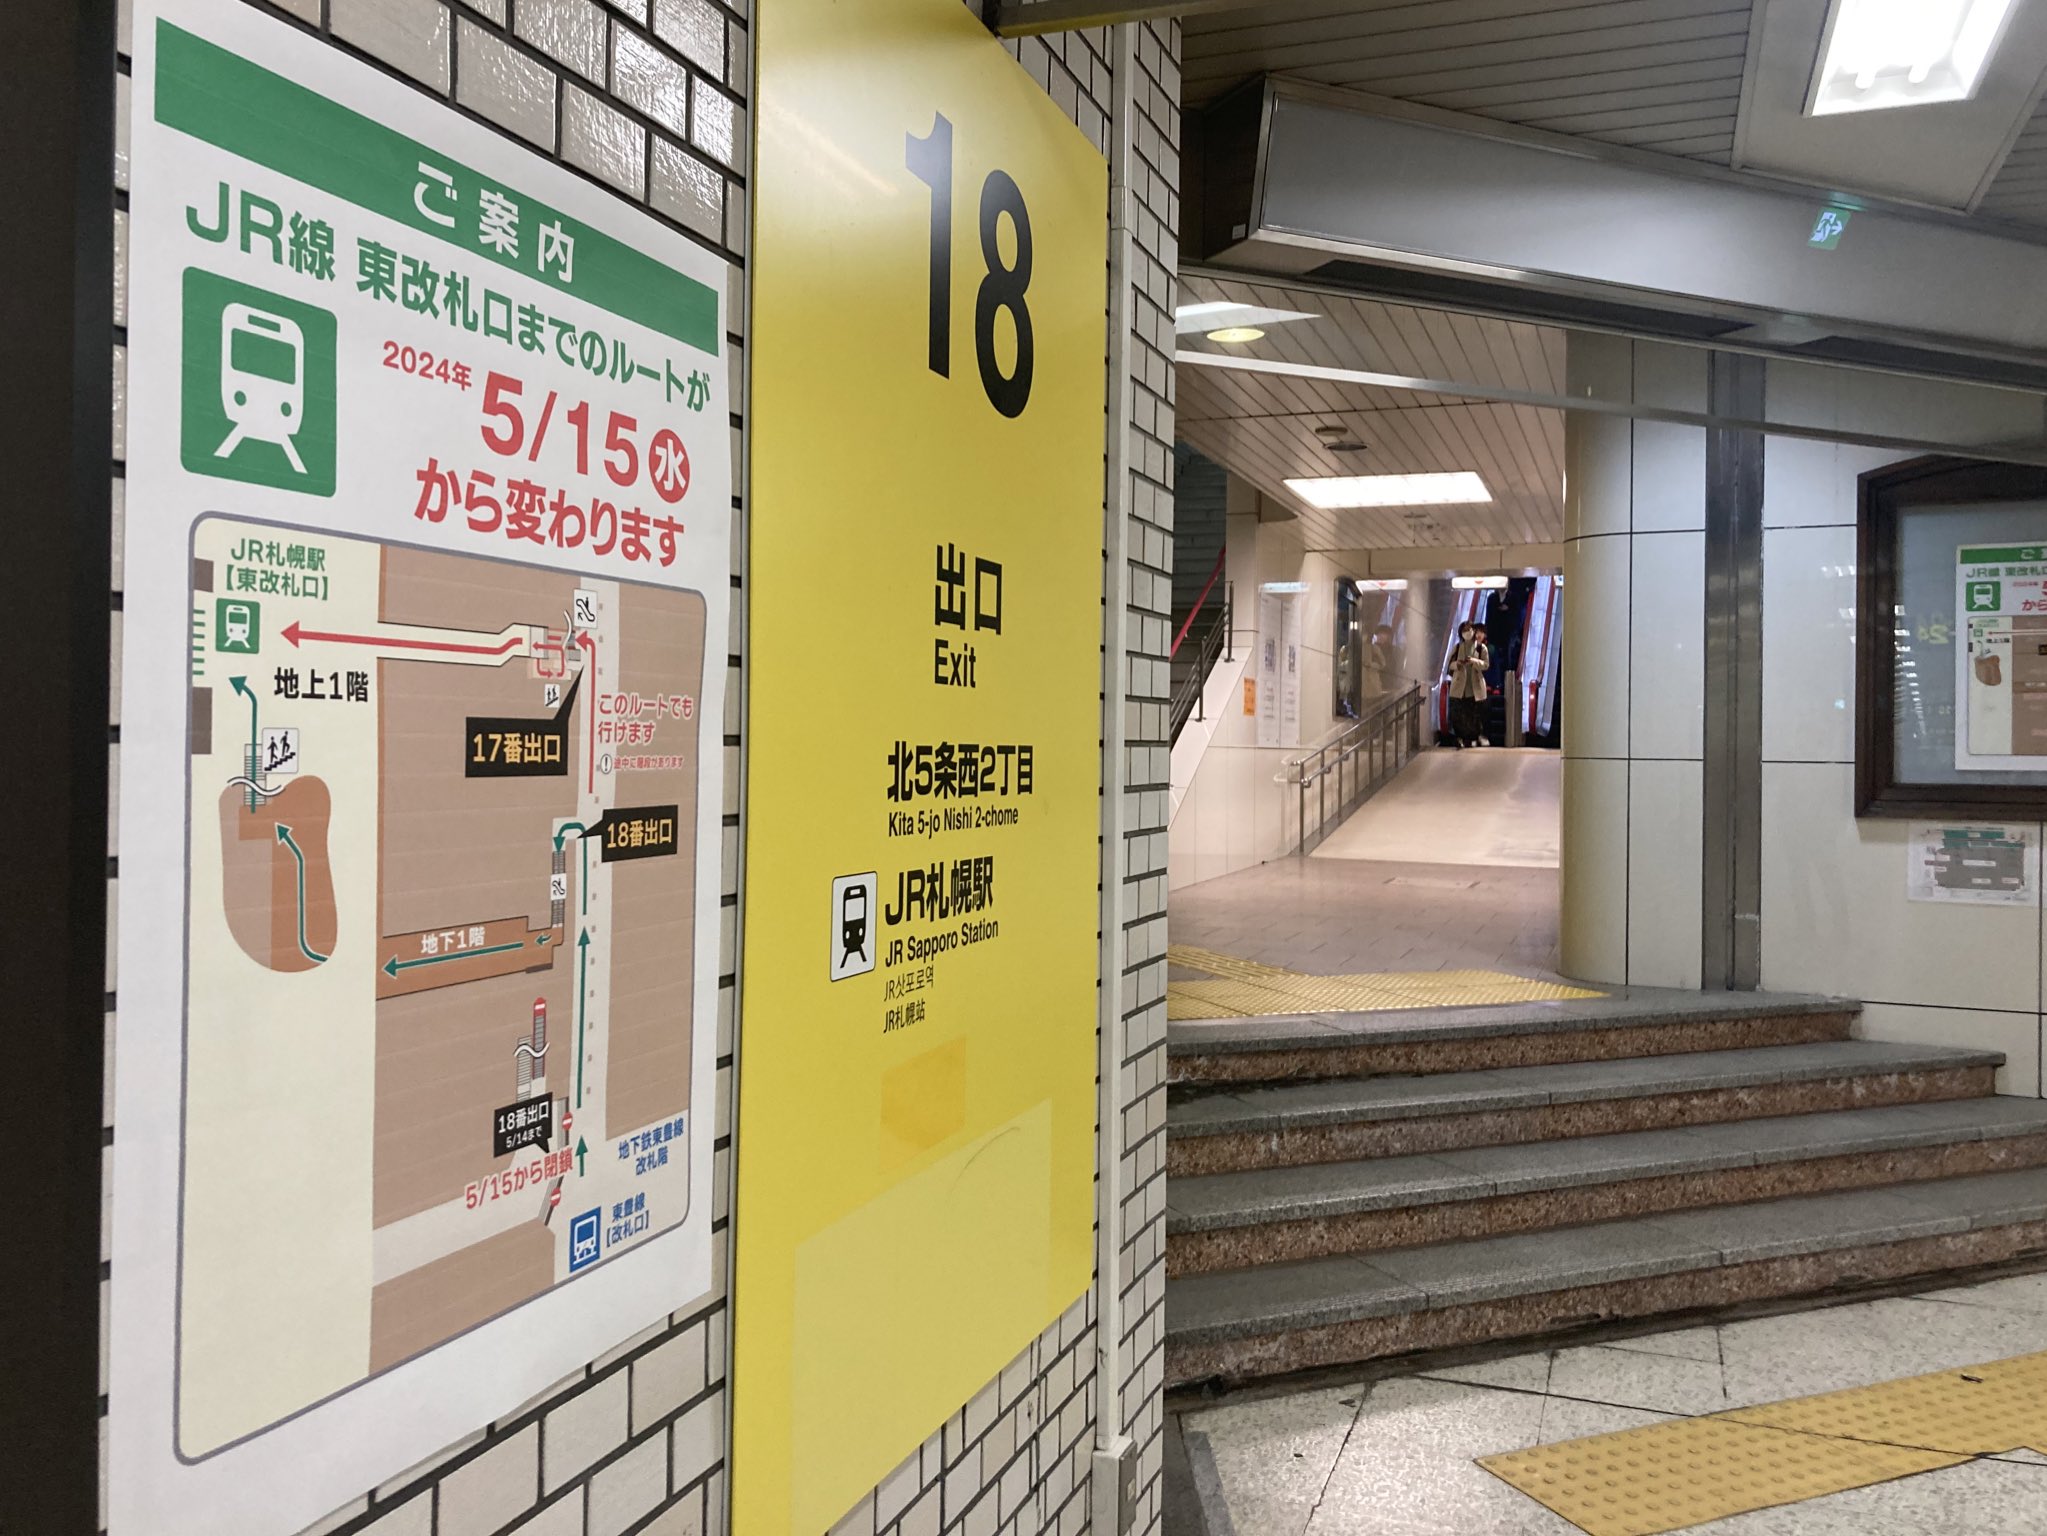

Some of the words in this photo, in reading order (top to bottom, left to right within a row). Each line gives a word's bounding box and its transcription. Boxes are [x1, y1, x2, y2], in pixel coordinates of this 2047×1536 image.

[414, 161, 575, 283] ご案内
[905, 110, 1034, 419] 18
[186, 181, 336, 283] JR線
[357, 236, 711, 413] 東改札口までのルートが
[383, 340, 472, 391] 2024年
[414, 457, 684, 567] から変わります
[230, 538, 326, 572] JR札幌駅
[934, 542, 1002, 635] 出口
[934, 638, 976, 688] Exit
[274, 667, 369, 703] 地上1階
[599, 694, 692, 718] このルートでも
[473, 732, 561, 764] 17番出口
[598, 721, 655, 743] 行けます
[887, 740, 1034, 803] 北5条西2丁目
[607, 818, 672, 849] 18番出口
[888, 810, 914, 838] Kita
[917, 807, 940, 840] 5-jo
[943, 805, 972, 832] Nishi
[975, 803, 1019, 828] 2-chome
[885, 855, 994, 926] JR札幌駅
[420, 926, 485, 954] 地下1階
[885, 938, 903, 968] JR
[907, 929, 958, 965] Sapporo
[961, 918, 999, 948] Station
[883, 964, 934, 1003] JR삿포로역
[883, 997, 926, 1034] JR札幌站
[498, 1101, 549, 1134] 18番出口
[506, 1126, 543, 1148] 5/14まで
[618, 1117, 684, 1160] 地下鉄東豊線
[466, 1147, 573, 1210] 5/15から閉鎖
[635, 1149, 669, 1176] 改札階
[611, 1191, 646, 1222] 東豊線
